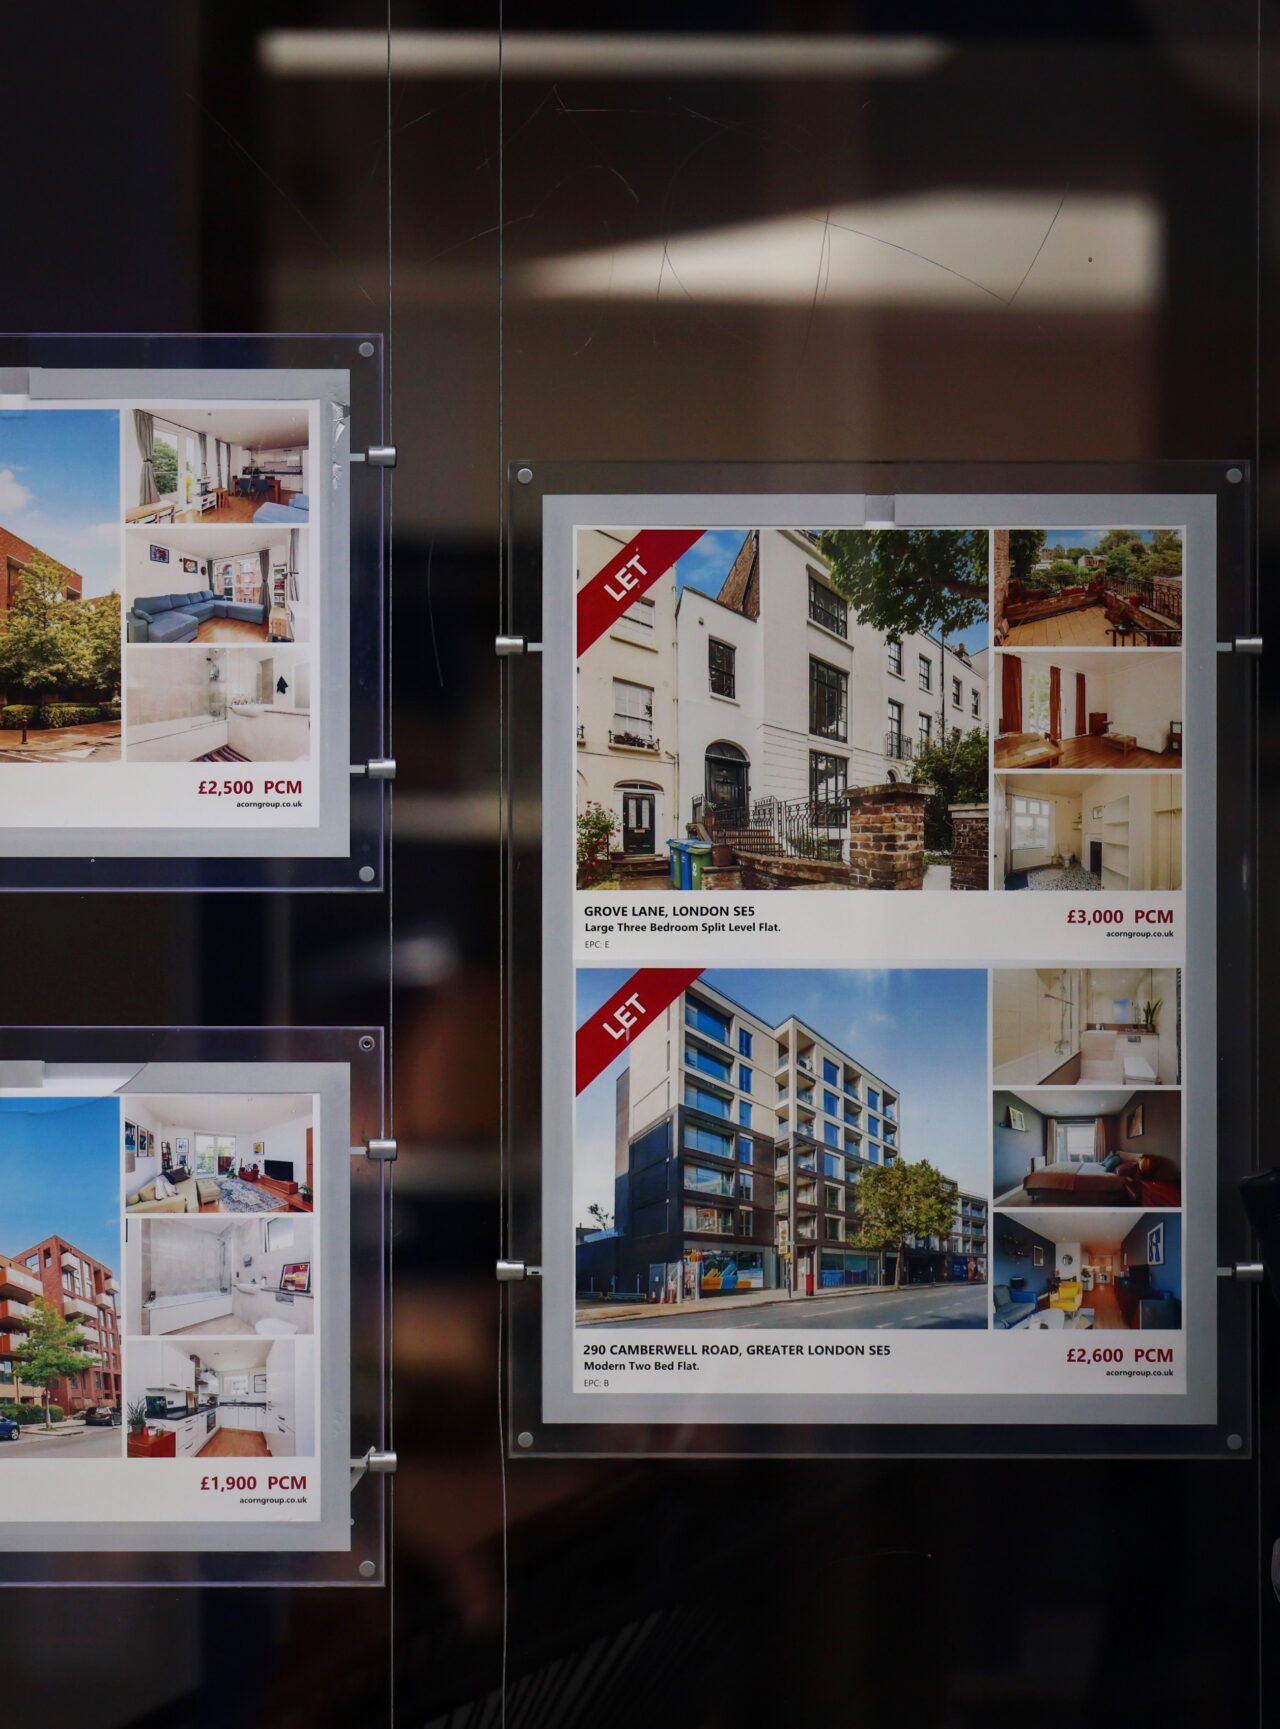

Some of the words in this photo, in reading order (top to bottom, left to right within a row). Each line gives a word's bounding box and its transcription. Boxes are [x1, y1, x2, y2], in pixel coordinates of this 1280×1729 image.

[603, 553, 648, 602] LET
[197, 780, 254, 797] £2,500
[264, 780, 302, 795] PCM
[236, 800, 303, 810] acorngroup.co.uk
[584, 905, 628, 917] GROVE
[631, 906, 668, 919] LANE,
[672, 905, 730, 917] LONDON
[733, 905, 755, 917] SE5
[1066, 909, 1124, 926] £3,000
[1134, 909, 1174, 924] PCM
[585, 922, 615, 935] Large
[616, 922, 647, 932] Three
[649, 922, 699, 932] Bedroom
[701, 922, 726, 935] Split
[728, 922, 756, 932] Level
[758, 922, 781, 932] Flat.
[1106, 929, 1174, 940] acorngroup.co.uk
[584, 940, 602, 949] EPC:
[604, 940, 609, 949] E
[601, 992, 647, 1040] LET
[583, 1344, 607, 1356] 290
[609, 1344, 698, 1356] CAMBERWELL
[701, 1344, 742, 1357] ROAD,
[746, 1344, 804, 1356] GREATER
[808, 1344, 865, 1356] LONDON
[868, 1344, 891, 1356] SE5
[1066, 1348, 1124, 1365] £2,600
[1134, 1348, 1174, 1363] PCM
[584, 1360, 626, 1371] Modern
[628, 1361, 652, 1371] Two
[654, 1360, 675, 1371] Bed
[677, 1360, 700, 1371] Flat.
[1105, 1368, 1174, 1379] acorngroup.co.uk
[583, 1378, 601, 1388] EPC:
[603, 1379, 610, 1388] B
[200, 1475, 257, 1493] £1,900
[267, 1475, 307, 1491] PCM
[239, 1495, 308, 1506] acorngroup.co.uk
